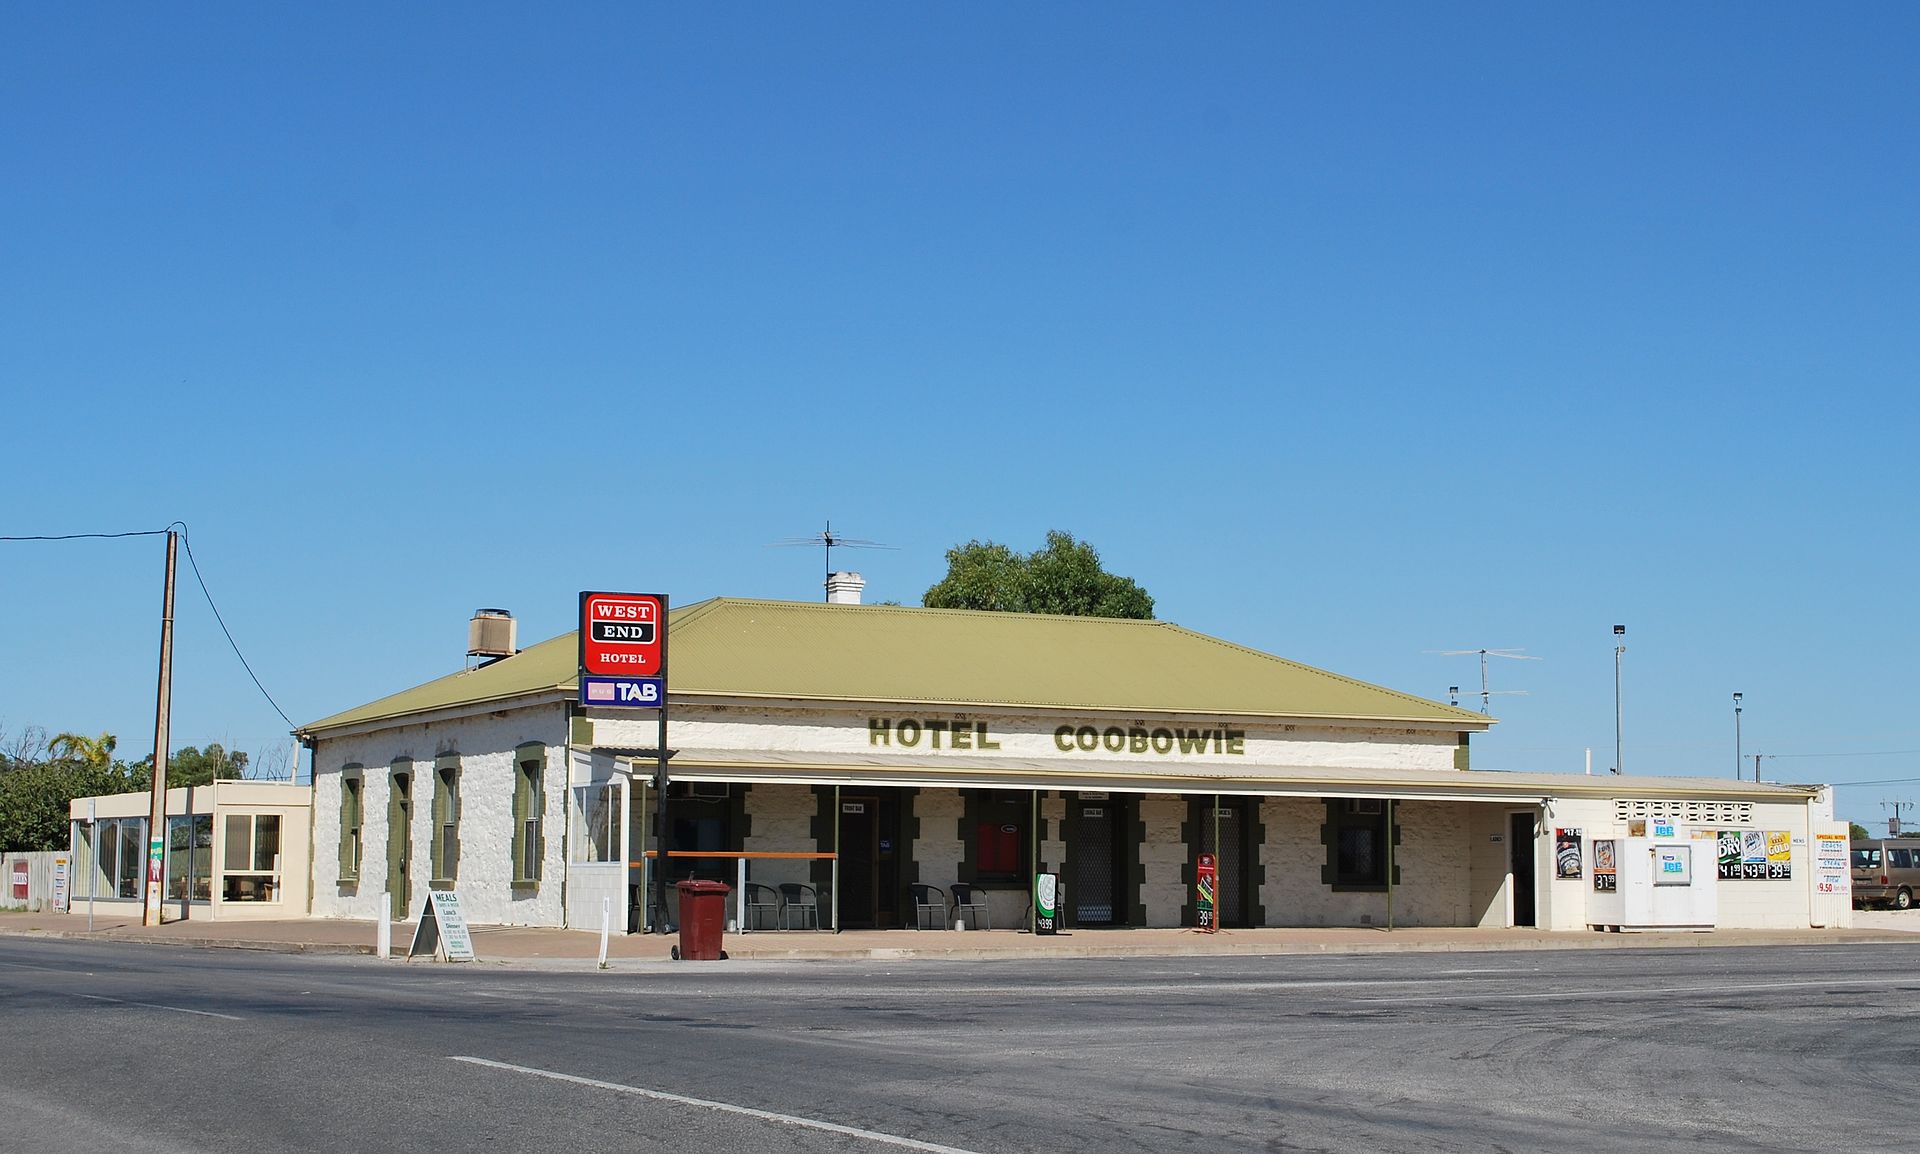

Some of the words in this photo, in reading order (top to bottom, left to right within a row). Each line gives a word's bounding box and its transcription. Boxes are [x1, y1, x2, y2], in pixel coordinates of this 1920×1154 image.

[597, 605, 649, 618] WEST
[603, 625, 643, 639] END
[600, 653, 646, 664] HOTEL
[616, 683, 658, 702] TAB
[868, 718, 1000, 750] HOTEL
[1053, 725, 1246, 755] COOBOWIE
[1655, 826, 1674, 837] ICE
[1718, 842, 1741, 858] DRY
[1768, 843, 1790, 856] GOLD
[1663, 862, 1683, 873] ICE
[435, 893, 457, 902] MEALS
